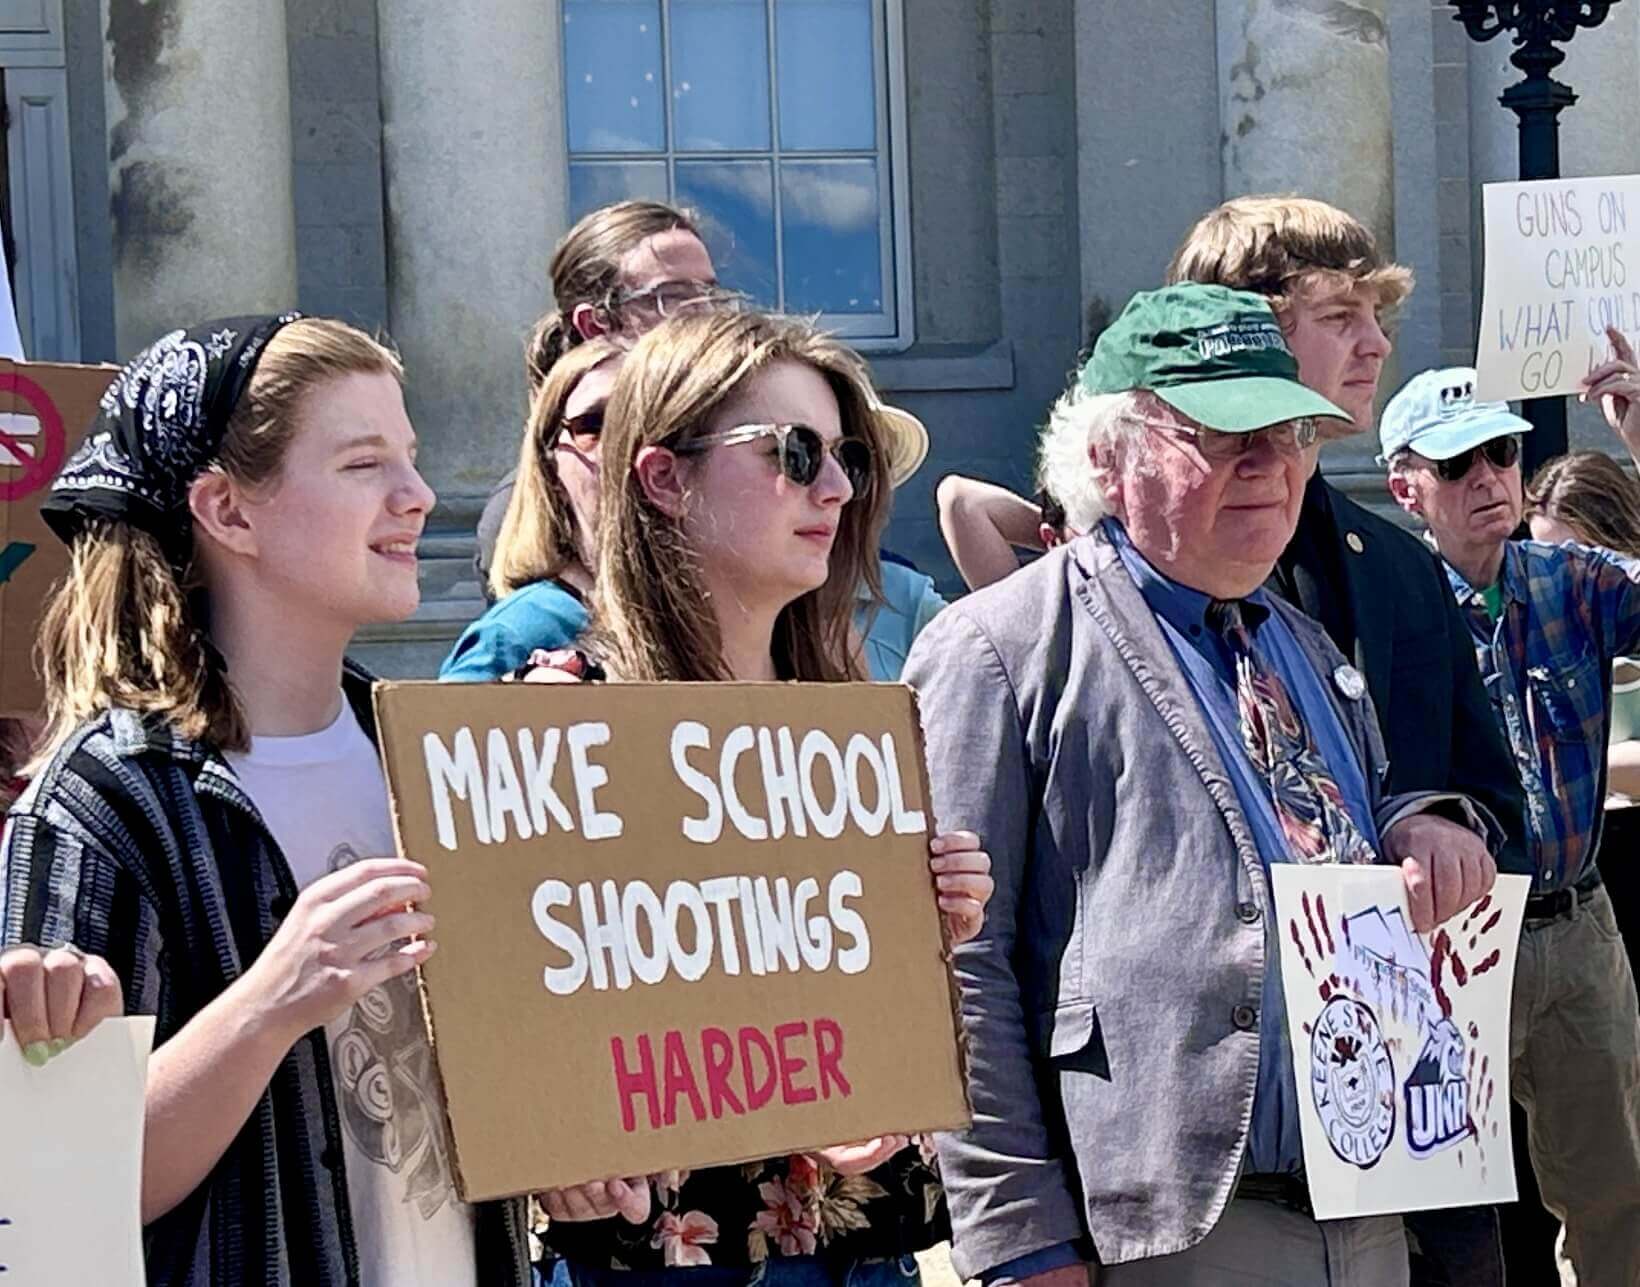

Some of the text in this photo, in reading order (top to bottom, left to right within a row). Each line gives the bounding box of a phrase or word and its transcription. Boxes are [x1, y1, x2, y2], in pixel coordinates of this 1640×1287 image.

[1516, 190, 1626, 237] GUNS ON
[1545, 242, 1626, 289] CAMPUS
[1500, 300, 1574, 350] WHAT
[1521, 350, 1563, 392] GO
[423, 720, 927, 850] MAKE SCHOOL
[532, 870, 870, 994] SHOOTINGS
[611, 1018, 851, 1132] HARDER
[1313, 1009, 1339, 1107] KEENE
[1407, 1081, 1468, 1149] UNH
